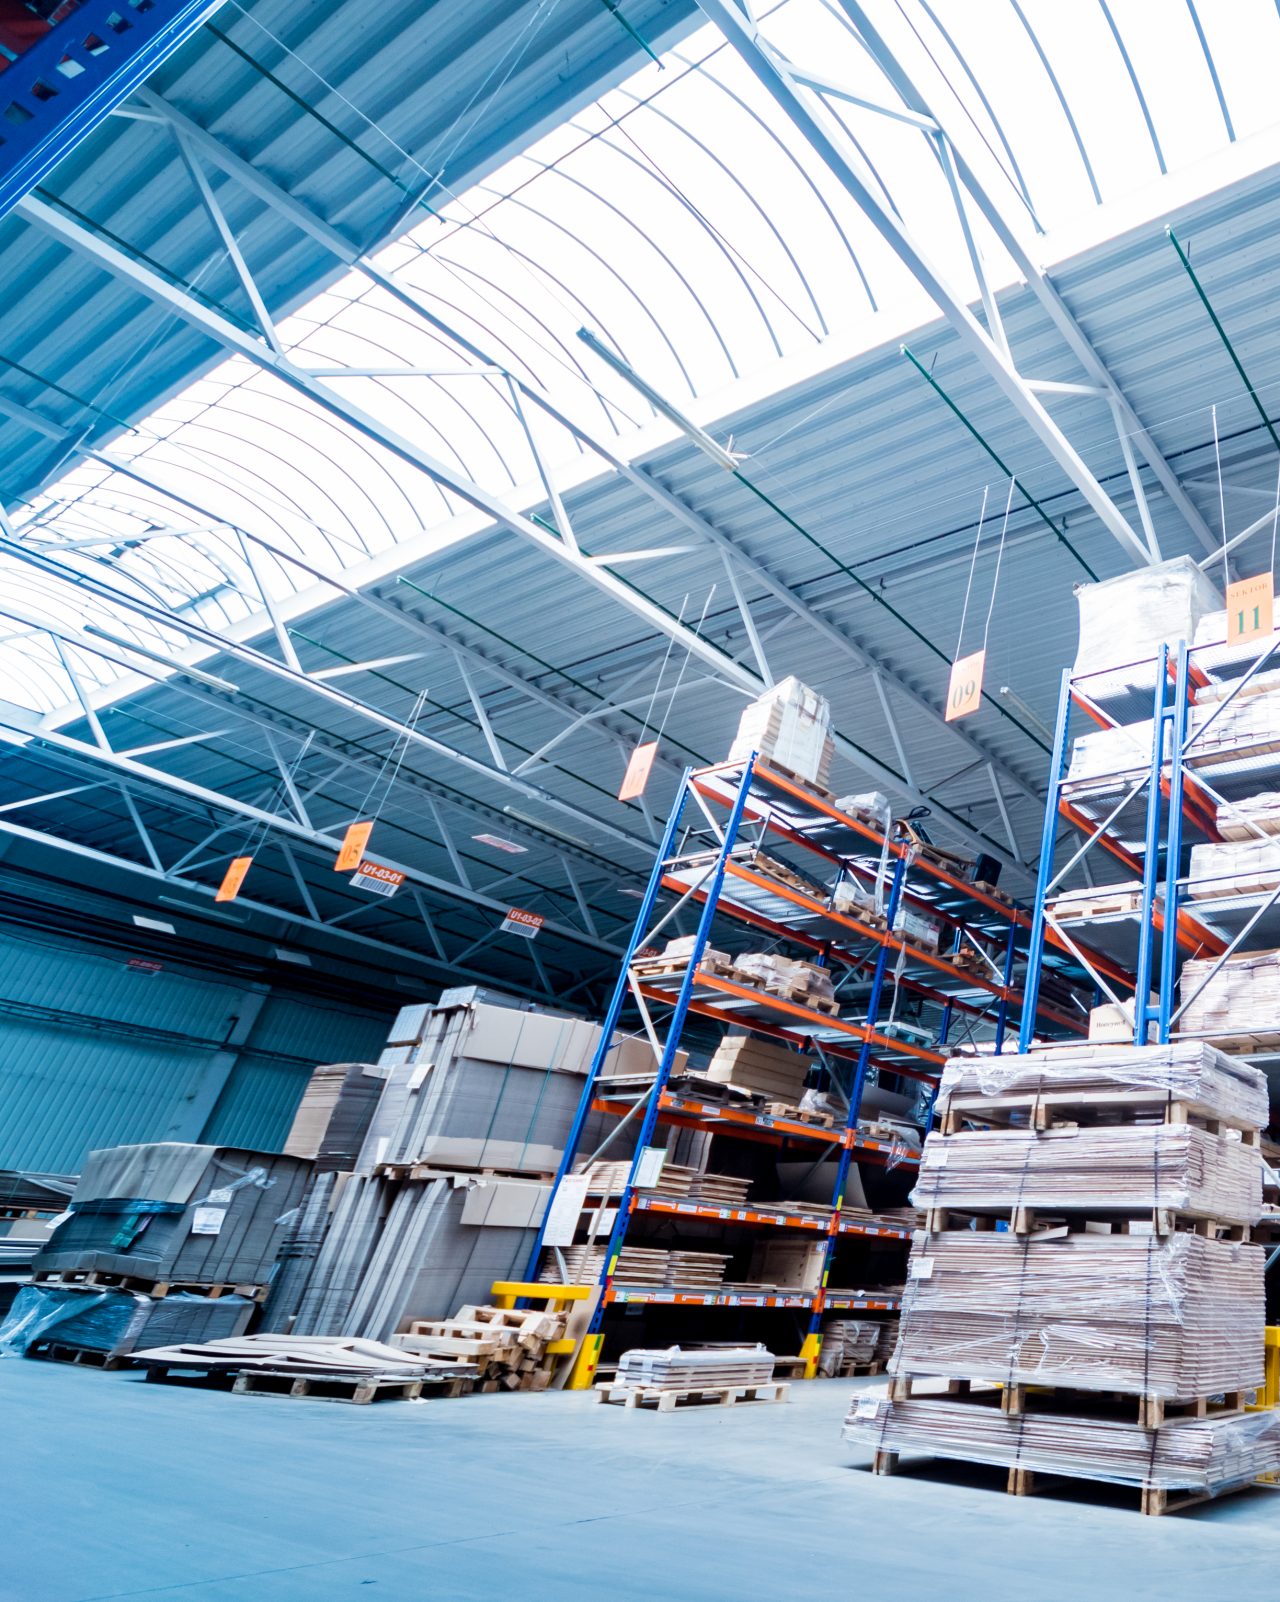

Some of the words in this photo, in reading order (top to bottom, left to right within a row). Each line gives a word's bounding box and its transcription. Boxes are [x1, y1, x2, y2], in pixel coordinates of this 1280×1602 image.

[1236, 604, 1262, 635] 11
[952, 680, 976, 709] 09
[362, 864, 402, 883] U1-03-01
